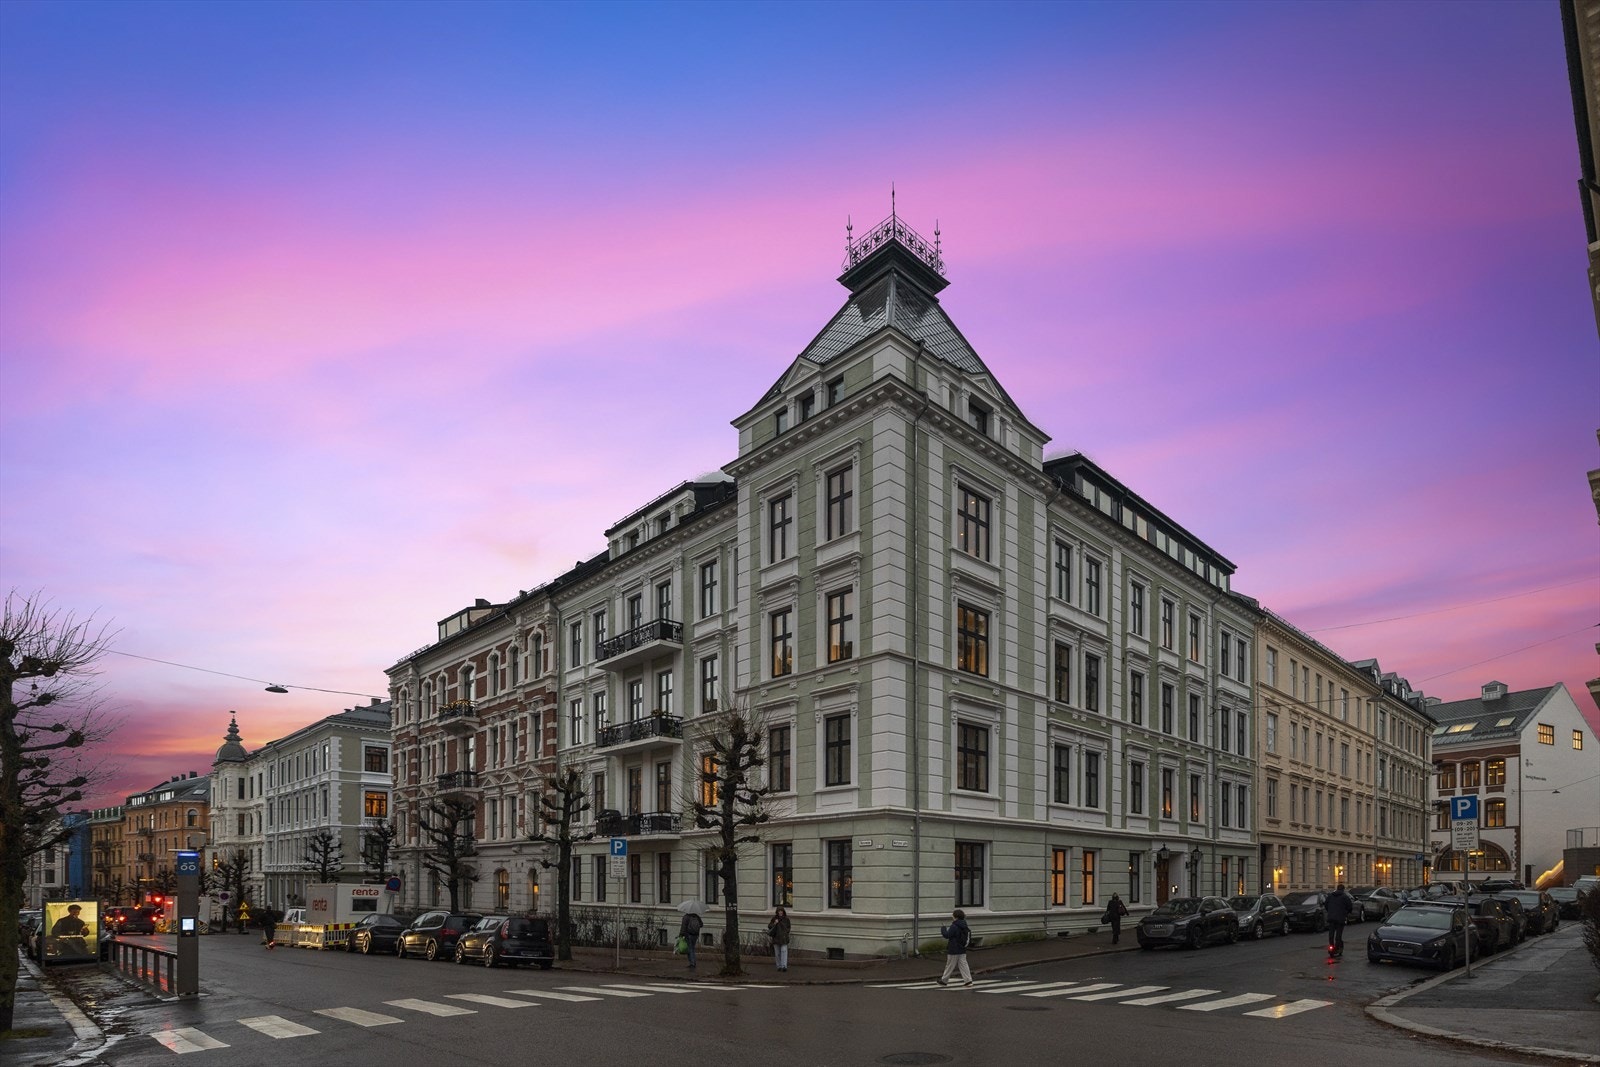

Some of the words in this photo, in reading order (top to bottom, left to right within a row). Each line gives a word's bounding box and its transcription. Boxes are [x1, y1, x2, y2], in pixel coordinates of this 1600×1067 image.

[1457, 799, 1471, 817] P
[614, 840, 623, 854] P
[352, 888, 379, 896] renta
[313, 898, 327, 911] renta
